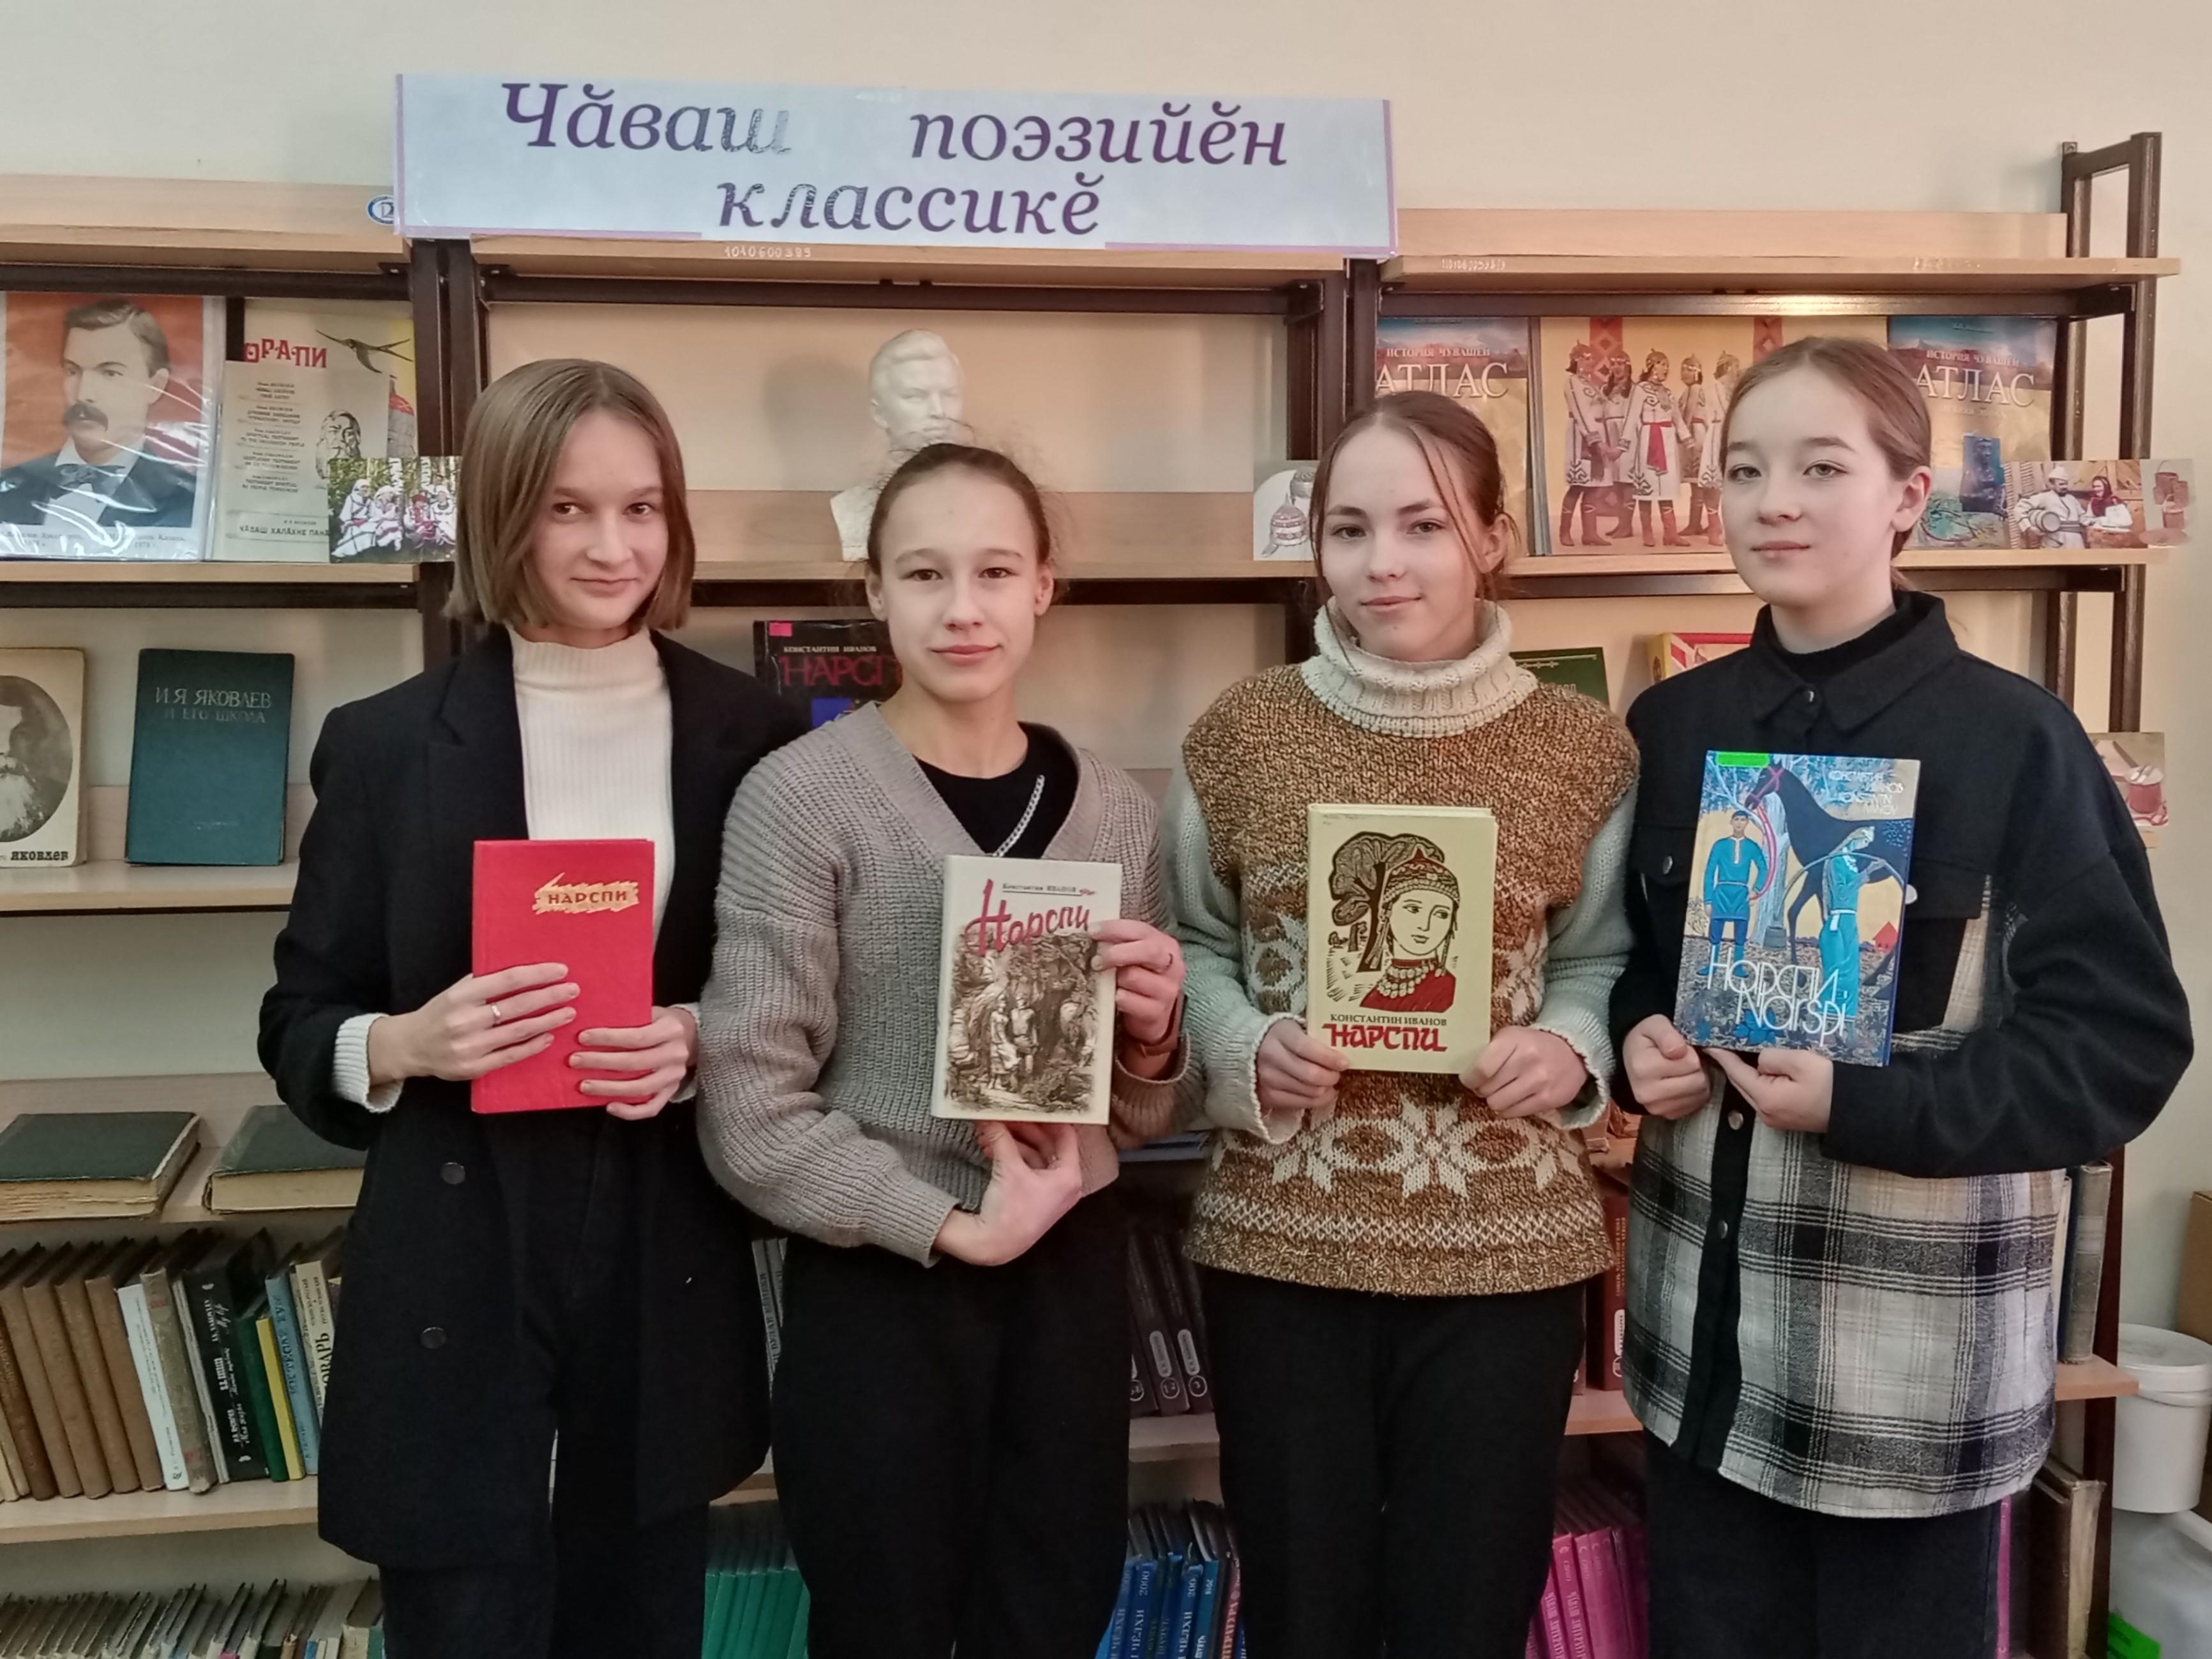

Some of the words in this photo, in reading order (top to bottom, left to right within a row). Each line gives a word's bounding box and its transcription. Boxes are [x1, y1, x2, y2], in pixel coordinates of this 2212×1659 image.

[502, 82, 792, 154] Чӑваш
[910, 101, 1288, 165] поэзийӗн
[717, 172, 1104, 236] классикӗ
[1387, 349, 1434, 358] ИСТОРИЯ
[1440, 347, 1490, 357] ЧУВАШЕЙ
[1926, 350, 1969, 362] ИСТОРИЯ
[1376, 363, 1509, 398] АТЛАС
[1916, 363, 2035, 407] АТЛАС
[548, 890, 628, 905] НАРСПИ
[964, 878, 1090, 957] Нарспи
[1330, 1014, 1403, 1025] КОНСТАНТИН
[1404, 1016, 1447, 1026] ИВАНОВ
[1736, 979, 1847, 1047] Narspi
